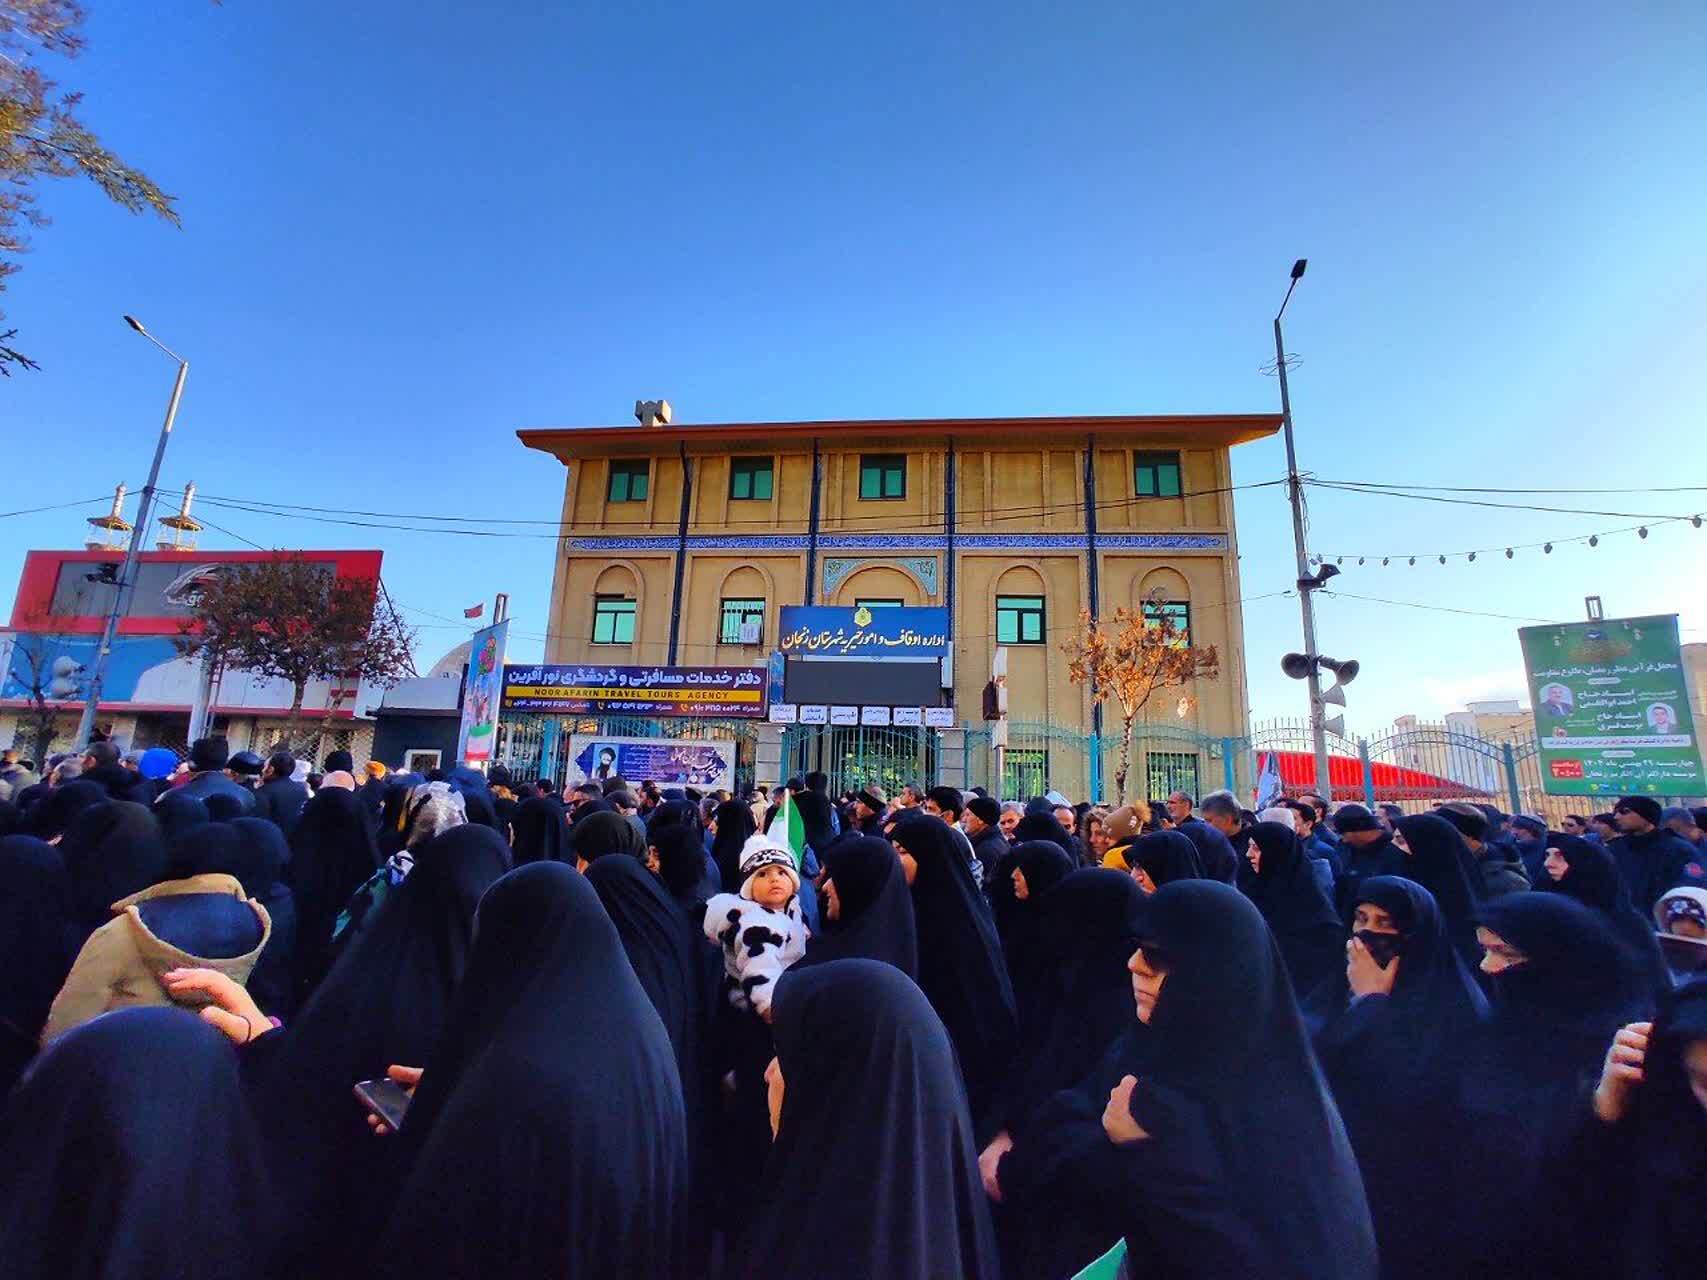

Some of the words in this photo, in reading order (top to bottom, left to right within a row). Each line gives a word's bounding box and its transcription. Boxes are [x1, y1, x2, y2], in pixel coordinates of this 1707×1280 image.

[782, 626, 810, 649] زنجان
[807, 628, 844, 650] شهرستان
[857, 632, 878, 645] امور
[878, 635, 885, 645] و
[884, 629, 921, 647] اوقاف
[922, 634, 945, 646] اداره
[560, 667, 617, 686] گردشگری
[619, 674, 627, 686] و
[629, 668, 685, 687] مسافرتی
[686, 670, 733, 684] خدمات
[733, 669, 761, 688] دفتر
[604, 690, 641, 698] TRAVEL
[647, 690, 681, 699] TOURS
[687, 691, 729, 700] AGENCY
